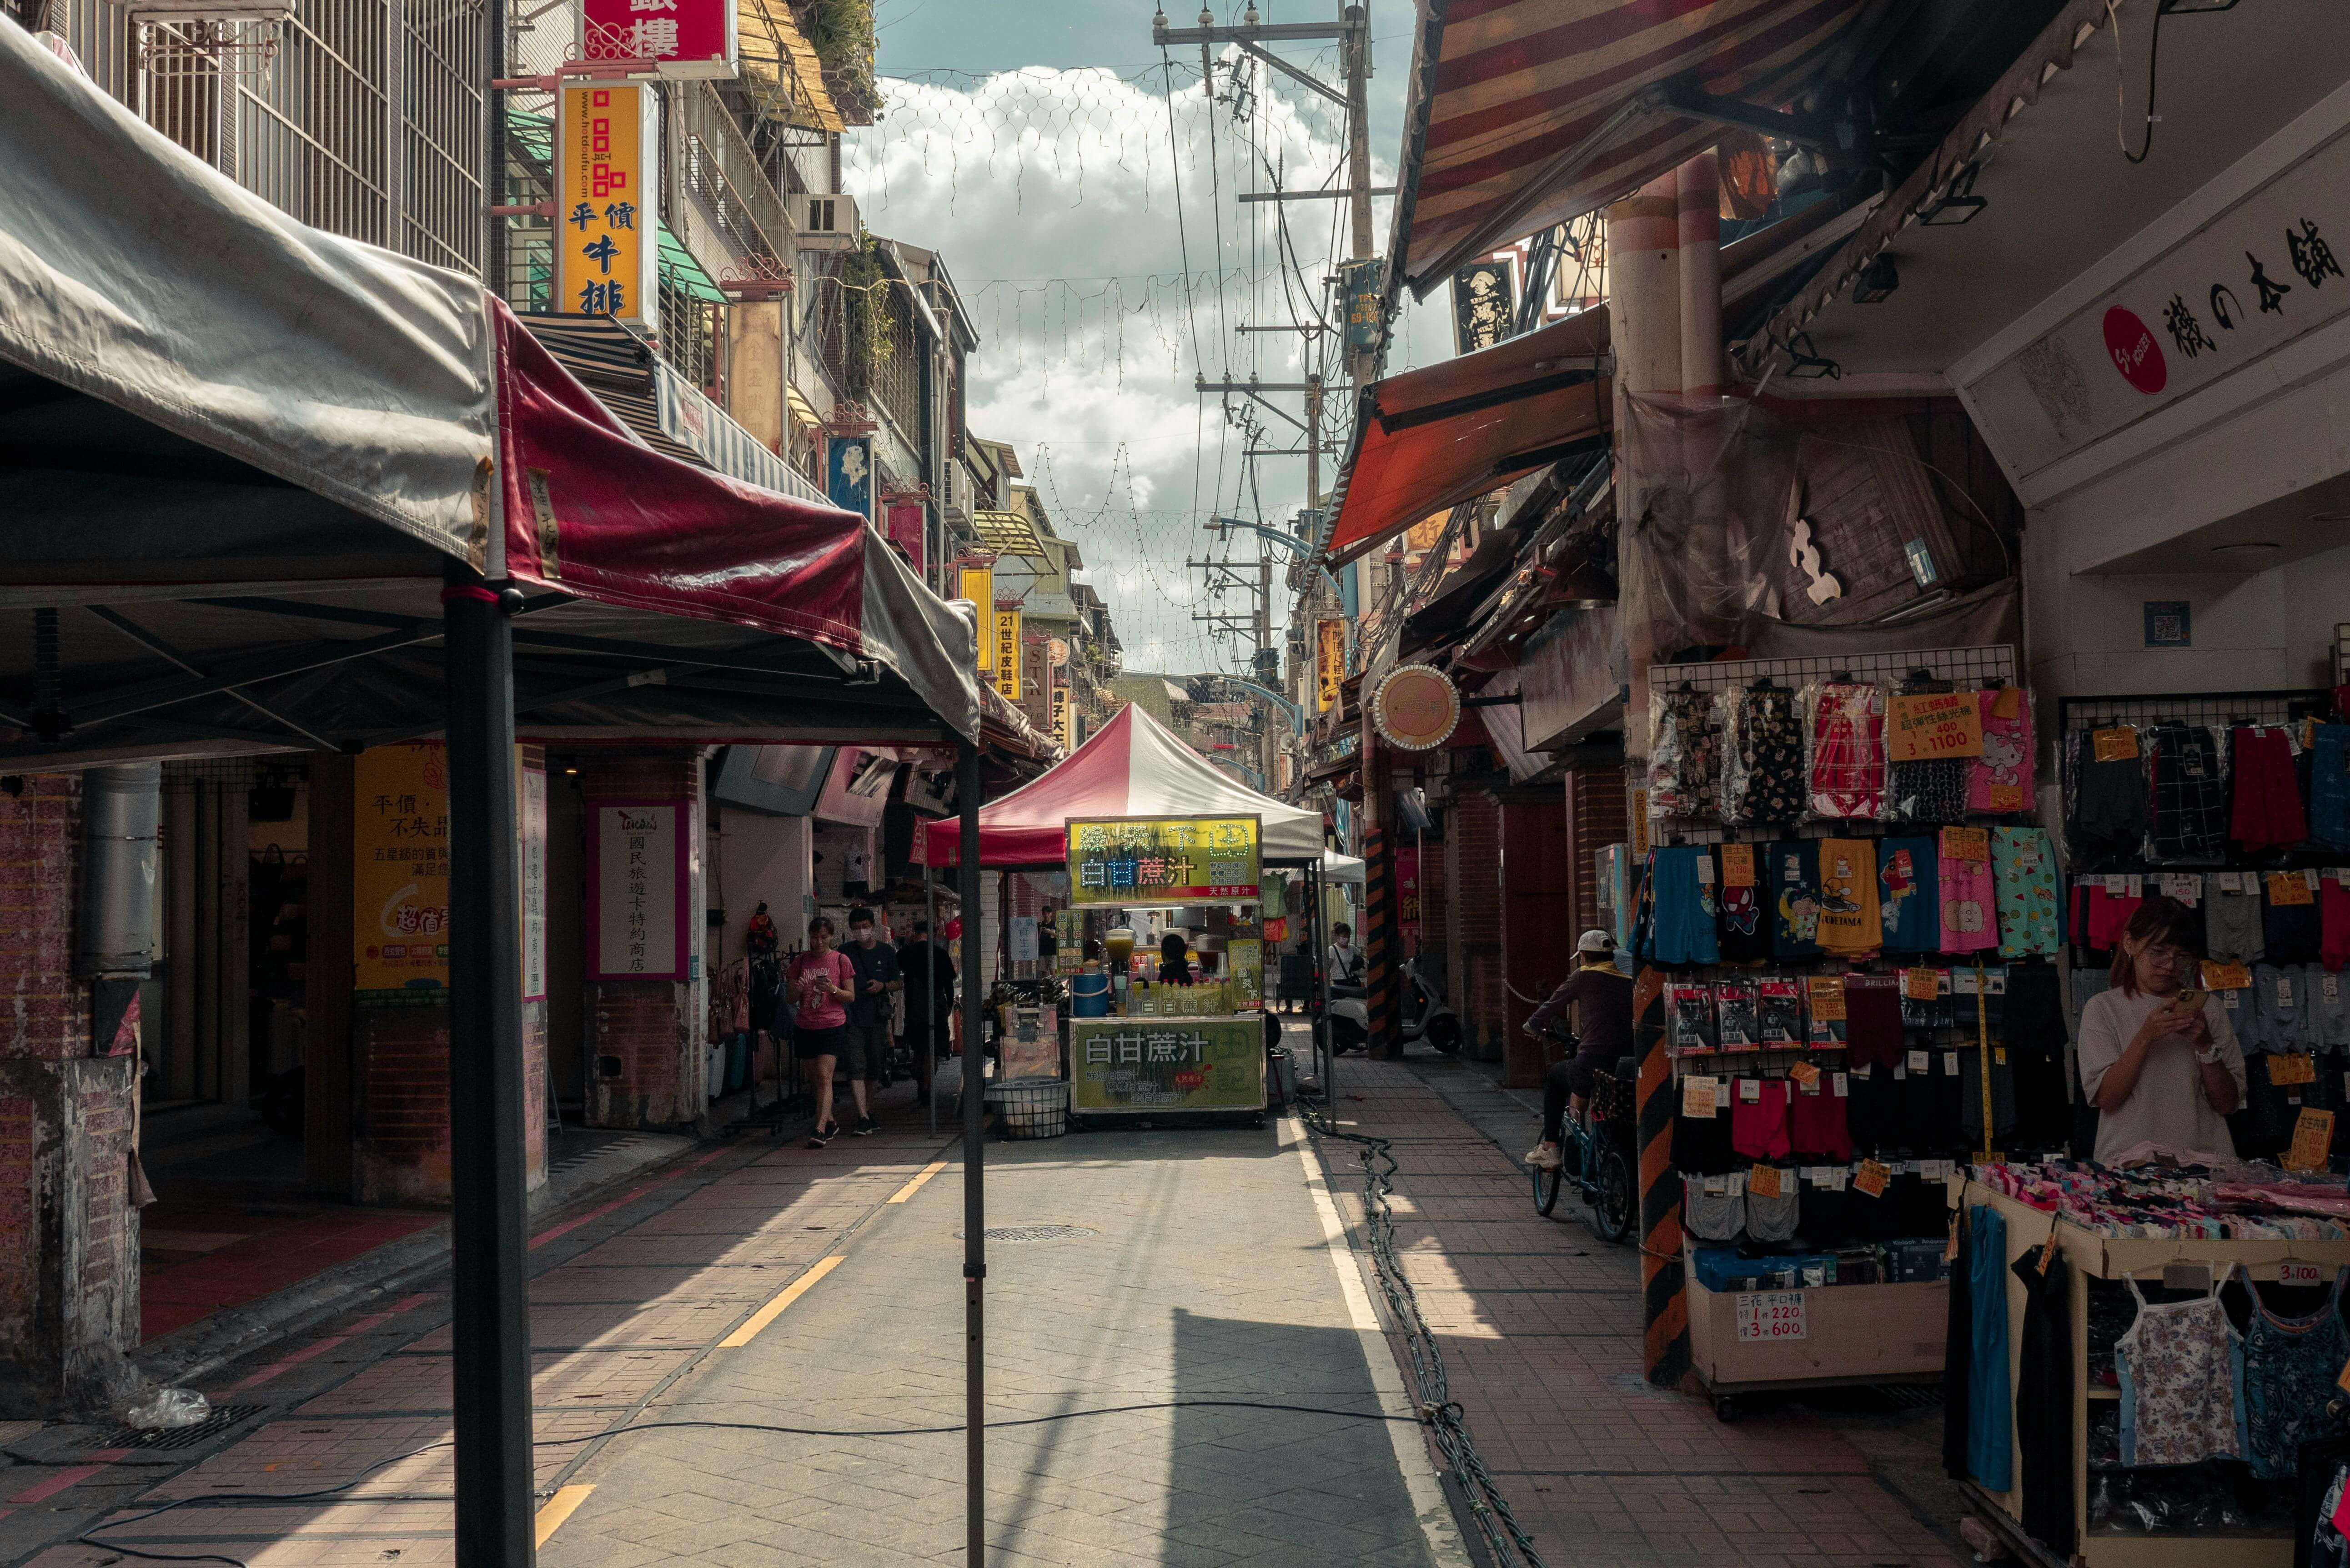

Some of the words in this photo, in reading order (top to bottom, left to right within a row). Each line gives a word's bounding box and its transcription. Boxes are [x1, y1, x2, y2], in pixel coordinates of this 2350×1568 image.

[568, 202, 637, 231] 平價
[1000, 616, 1013, 695] 21世紀皮鞋店
[372, 794, 417, 816] 平價
[1636, 792, 1646, 851] 251442
[1080, 856, 1195, 886] 白甘蔗汁
[628, 836, 648, 972] 國民旅遊卡特約商店
[1209, 887, 1250, 896] 天然原汁
[1142, 999, 1218, 1014] 白甘蔗汁
[1085, 1030, 1211, 1064] 白甘蔗汁
[1739, 1294, 1762, 1307] 三花
[1768, 1293, 1802, 1307] 平口褲
